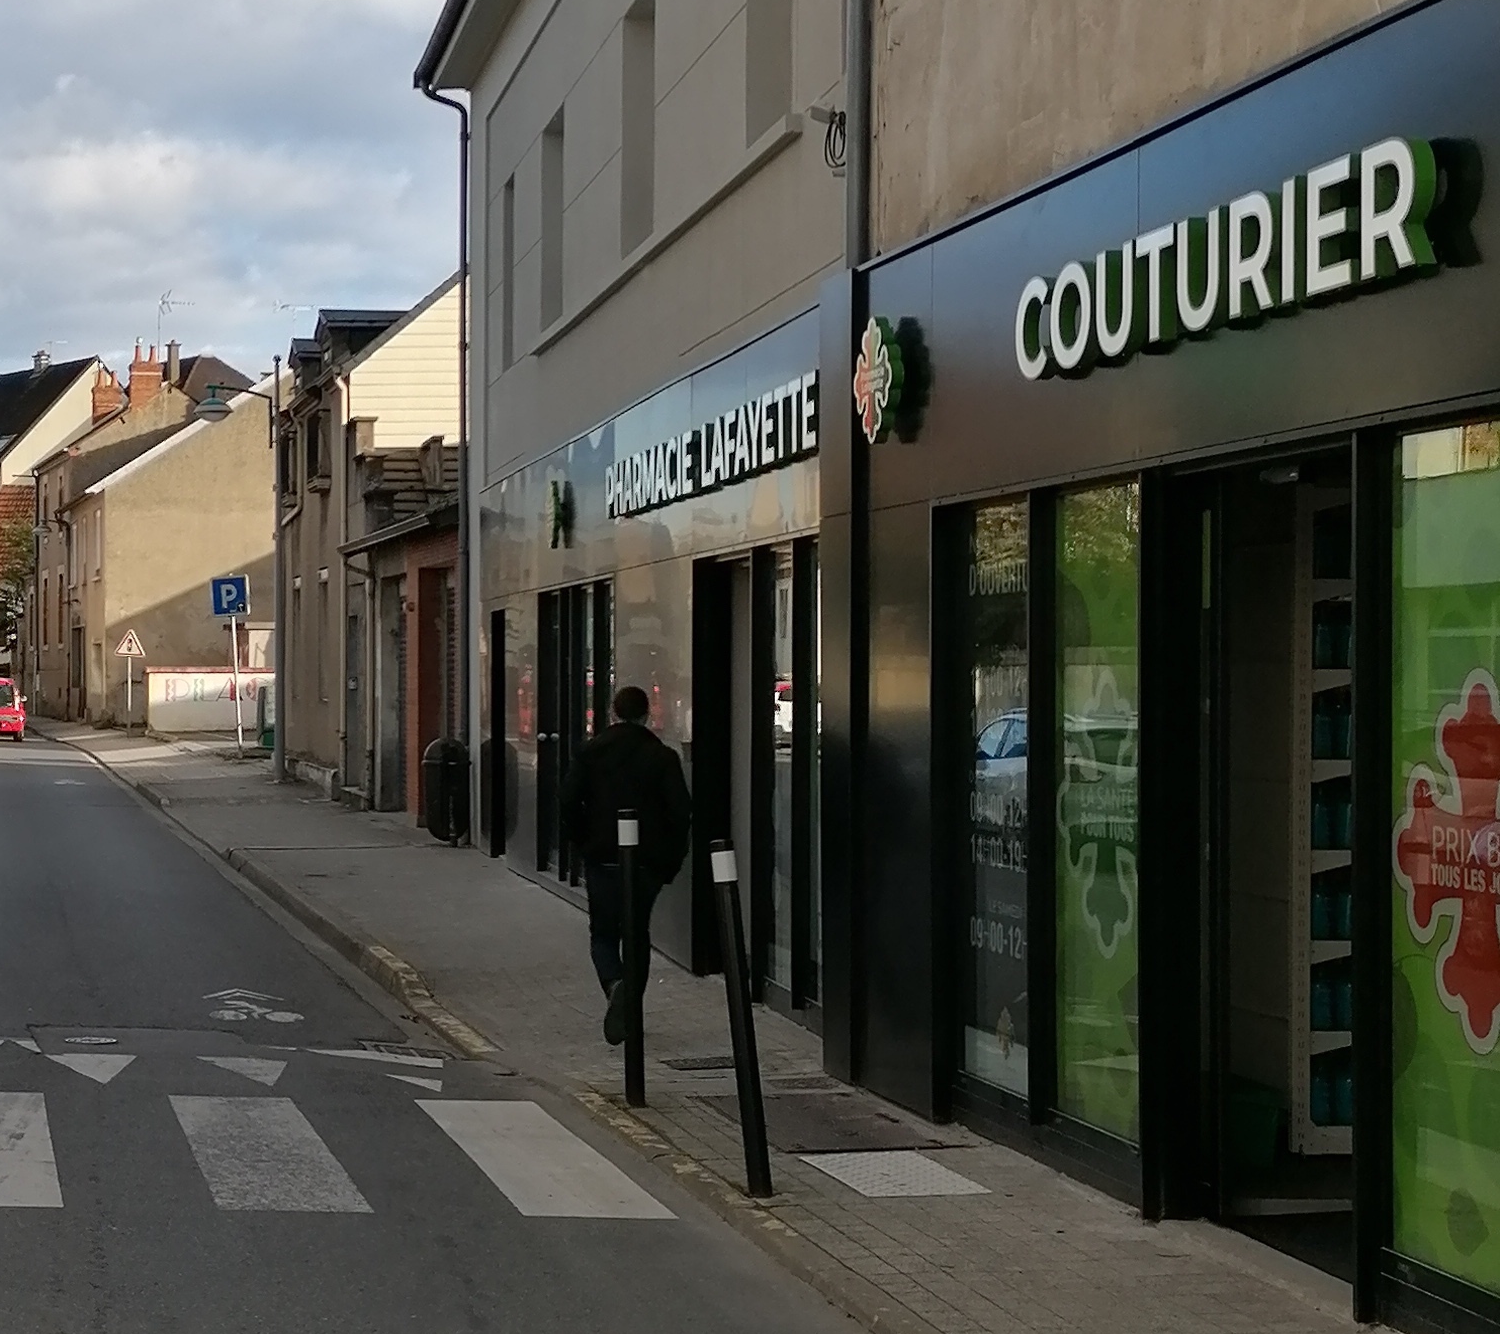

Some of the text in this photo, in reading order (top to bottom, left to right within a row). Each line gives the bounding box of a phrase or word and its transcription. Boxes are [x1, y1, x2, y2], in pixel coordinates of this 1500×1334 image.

[1015, 137, 1417, 381] COUTURIER
[606, 369, 818, 518] PHARMACIE LAFAYETTE
[220, 583, 238, 609] P
[1432, 825, 1481, 865] PRIX
[1431, 863, 1461, 889] TOUS
[1464, 868, 1486, 893] LES
